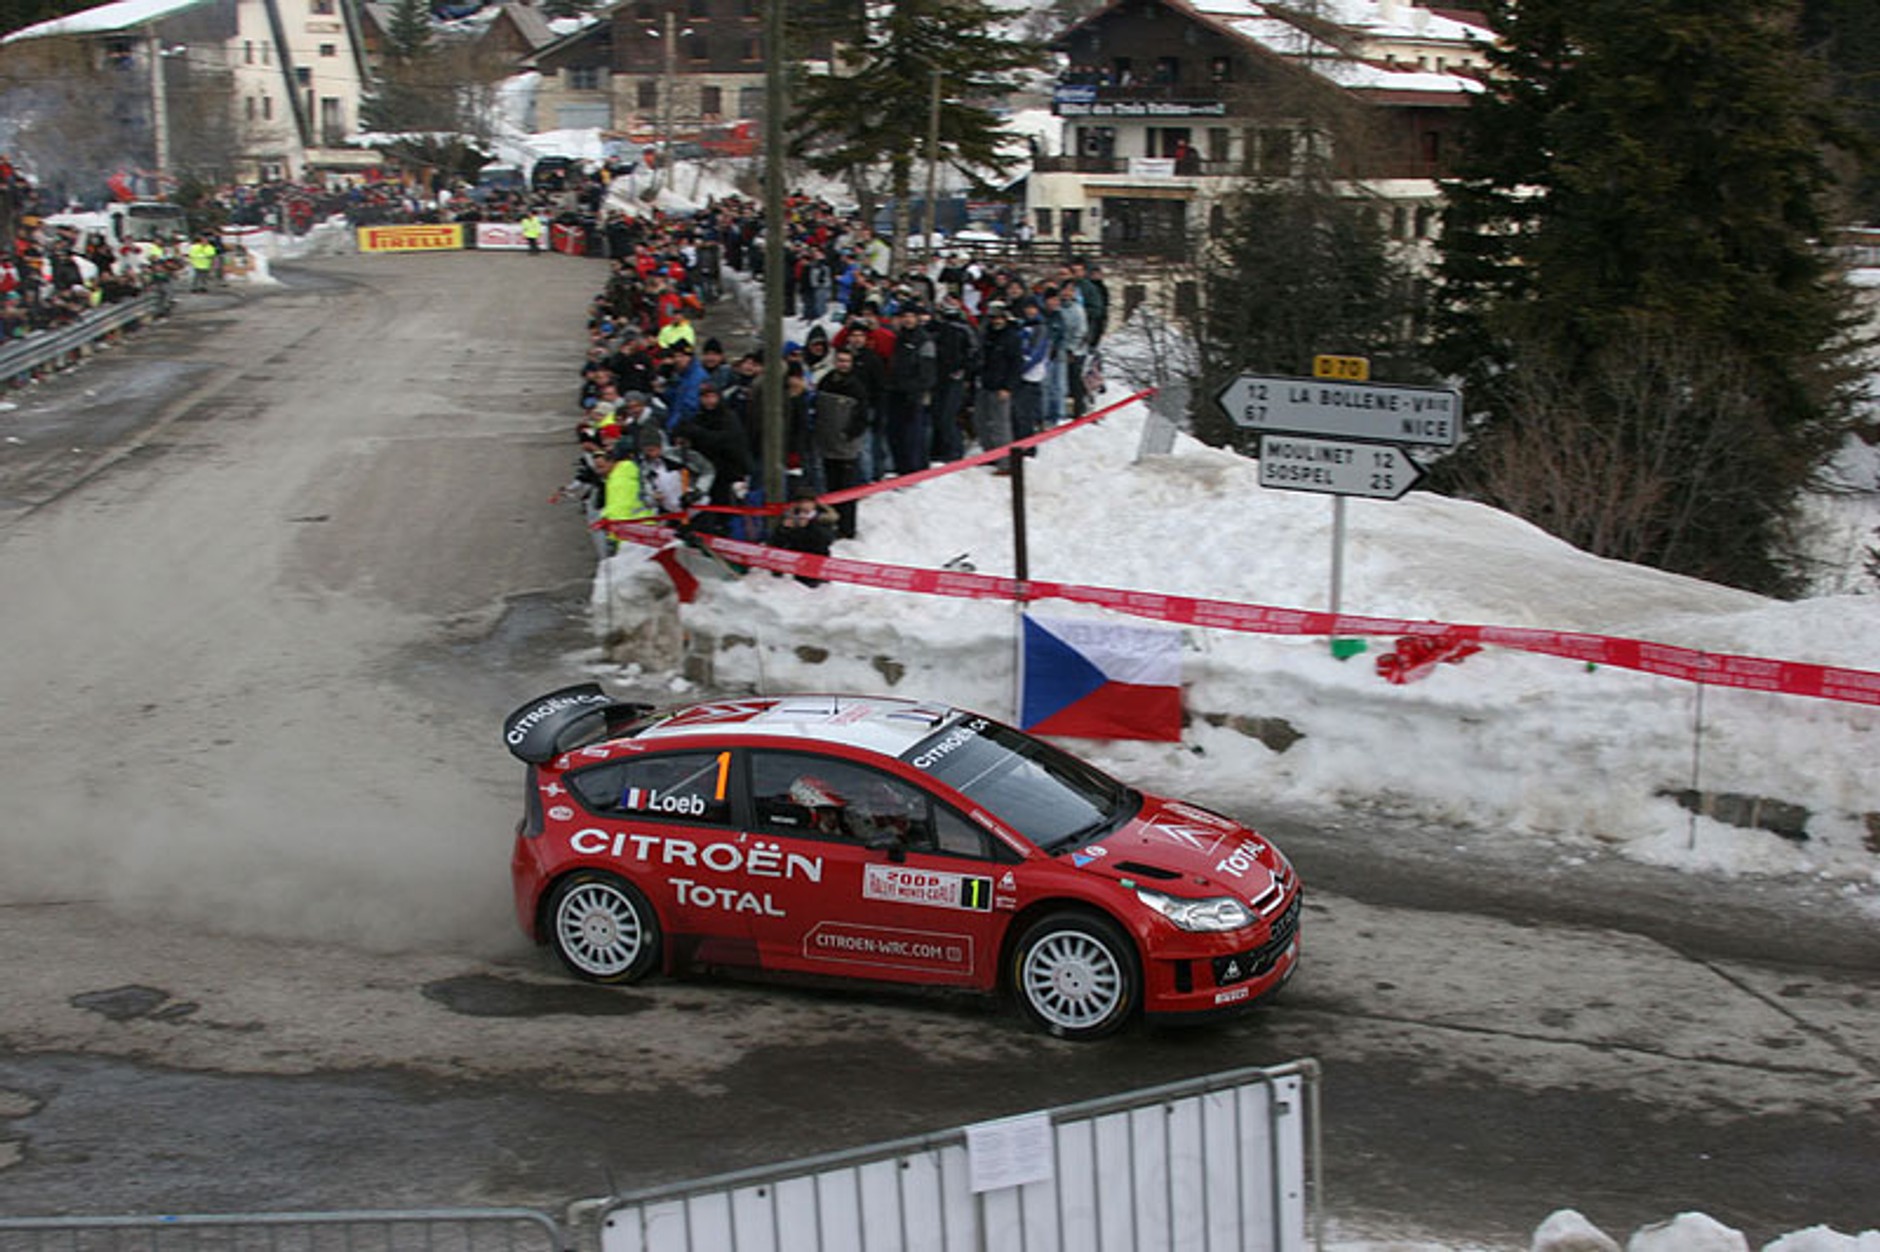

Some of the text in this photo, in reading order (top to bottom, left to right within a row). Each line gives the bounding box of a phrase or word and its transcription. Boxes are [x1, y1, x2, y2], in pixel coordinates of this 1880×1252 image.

[369, 227, 453, 249] PIRELLI
[1247, 384, 1269, 401] 12
[1289, 387, 1310, 404] LA
[1244, 405, 1449, 438] 67 NICE
[1266, 441, 1395, 469] MOULINET 12
[1265, 463, 1394, 490] SOSPEL 25
[714, 752, 732, 801] 1
[648, 788, 706, 816] Loeb
[569, 827, 824, 884] CITROËN
[1215, 839, 1266, 878] TOTAL
[667, 877, 787, 917] TOTAL
[970, 878, 980, 908] 1
[815, 933, 944, 960] CITROEN-WRC.COM
